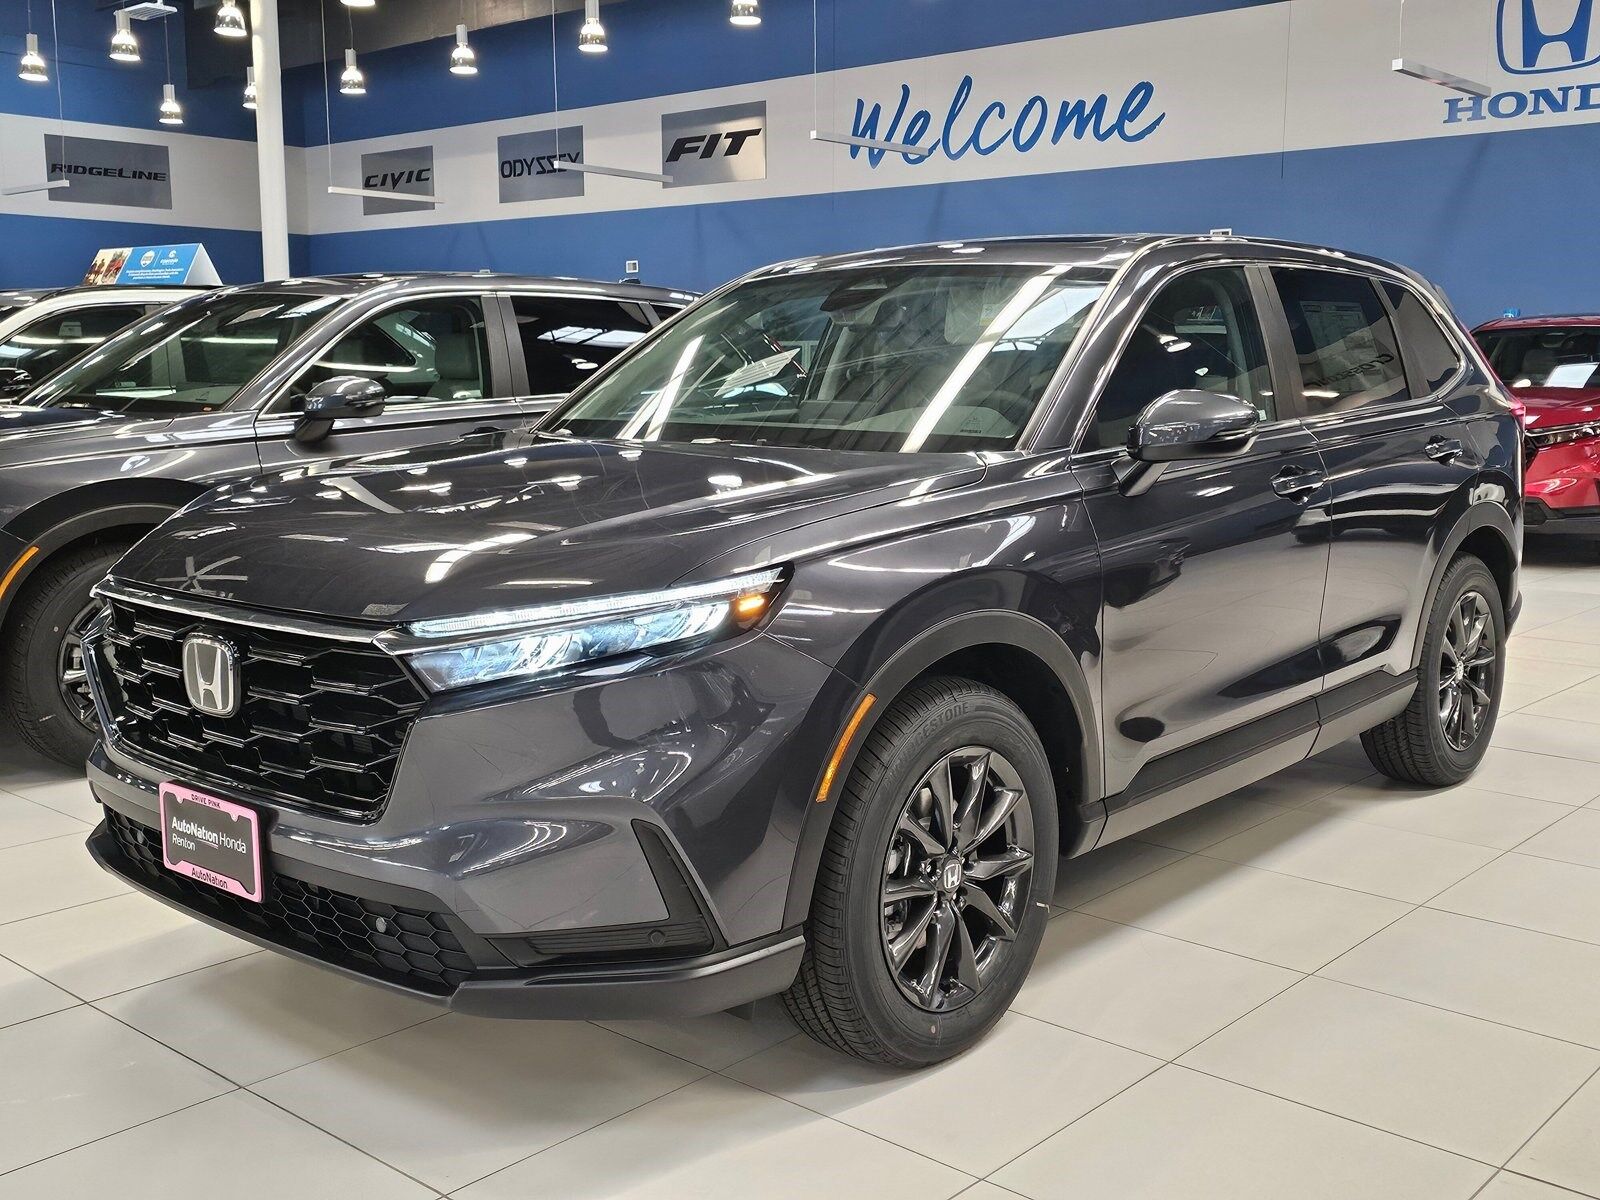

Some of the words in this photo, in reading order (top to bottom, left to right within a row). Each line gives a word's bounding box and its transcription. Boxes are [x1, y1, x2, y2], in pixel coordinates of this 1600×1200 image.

[849, 75, 1166, 169] Welcome
[665, 128, 762, 163] FIT
[51, 163, 167, 182] RIDGELINE
[501, 152, 580, 178] ODYSSEY
[365, 168, 431, 190] CIVIC
[191, 793, 207, 805] DRIVE
[208, 799, 221, 809] PINK
[172, 816, 219, 844] AutoNation
[219, 832, 247, 854] Honda
[172, 833, 196, 851] Renton
[191, 867, 228, 889] AutoNation
